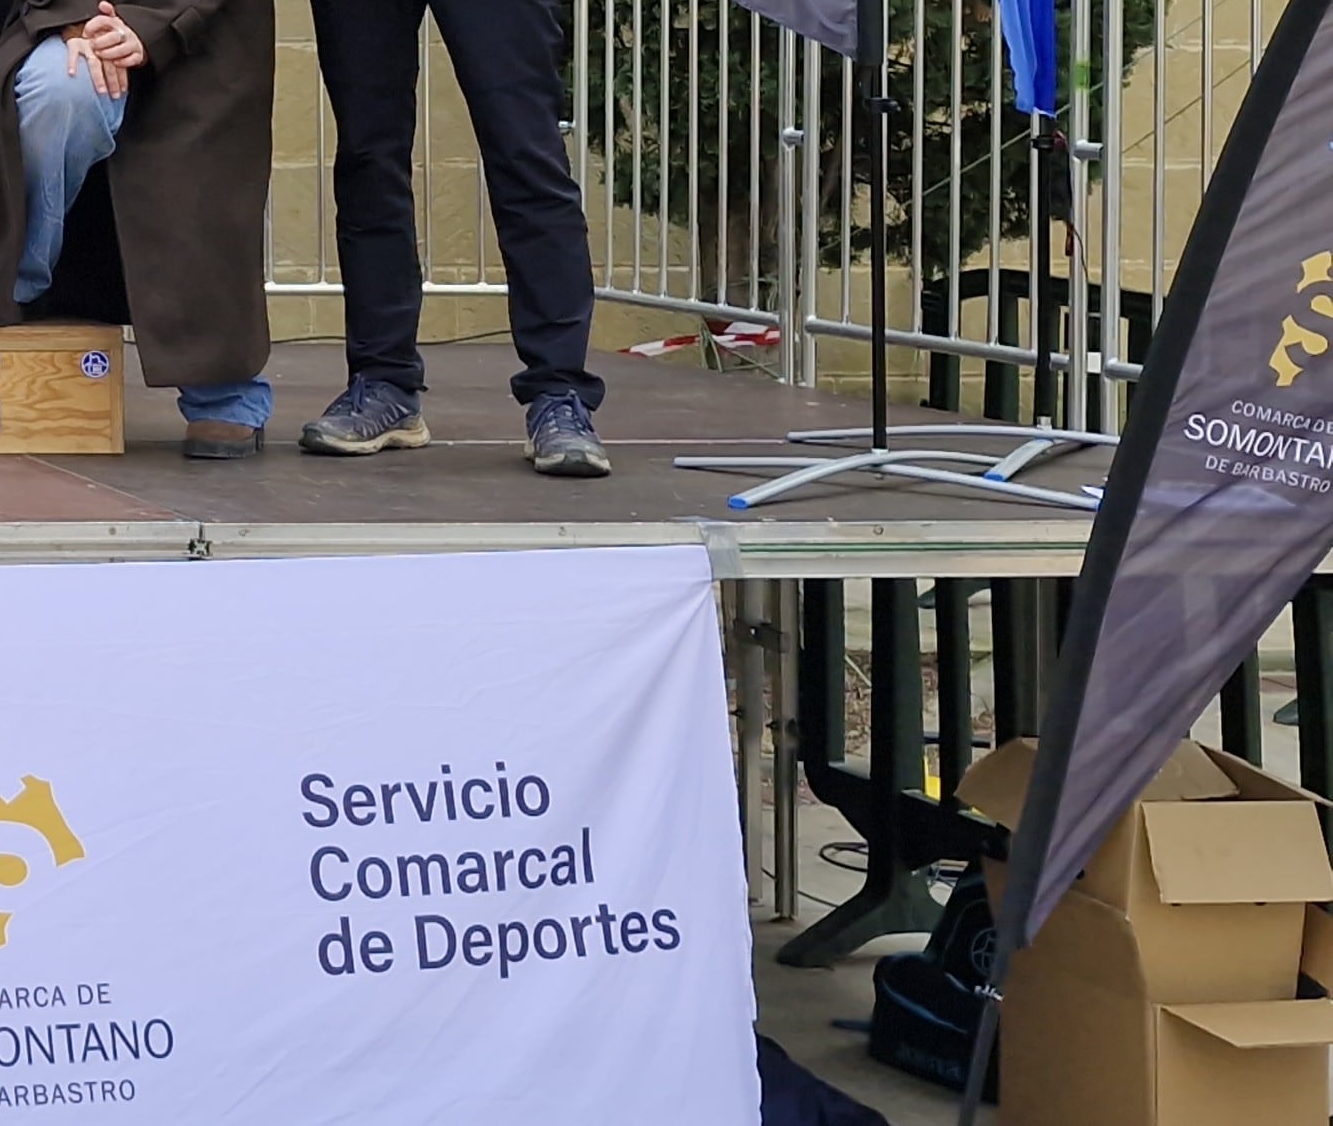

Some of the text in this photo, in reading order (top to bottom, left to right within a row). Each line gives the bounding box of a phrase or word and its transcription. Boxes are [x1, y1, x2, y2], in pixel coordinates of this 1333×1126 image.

[1183, 413, 1333, 470] SOMONTA
[1231, 399, 1311, 431] COMARCA
[1204, 454, 1331, 494] DE BARBASTRO
[300, 761, 550, 828] Servicio
[310, 826, 595, 902] Comarcal
[318, 903, 681, 979] de Deportes
[77, 982, 112, 1006] DE
